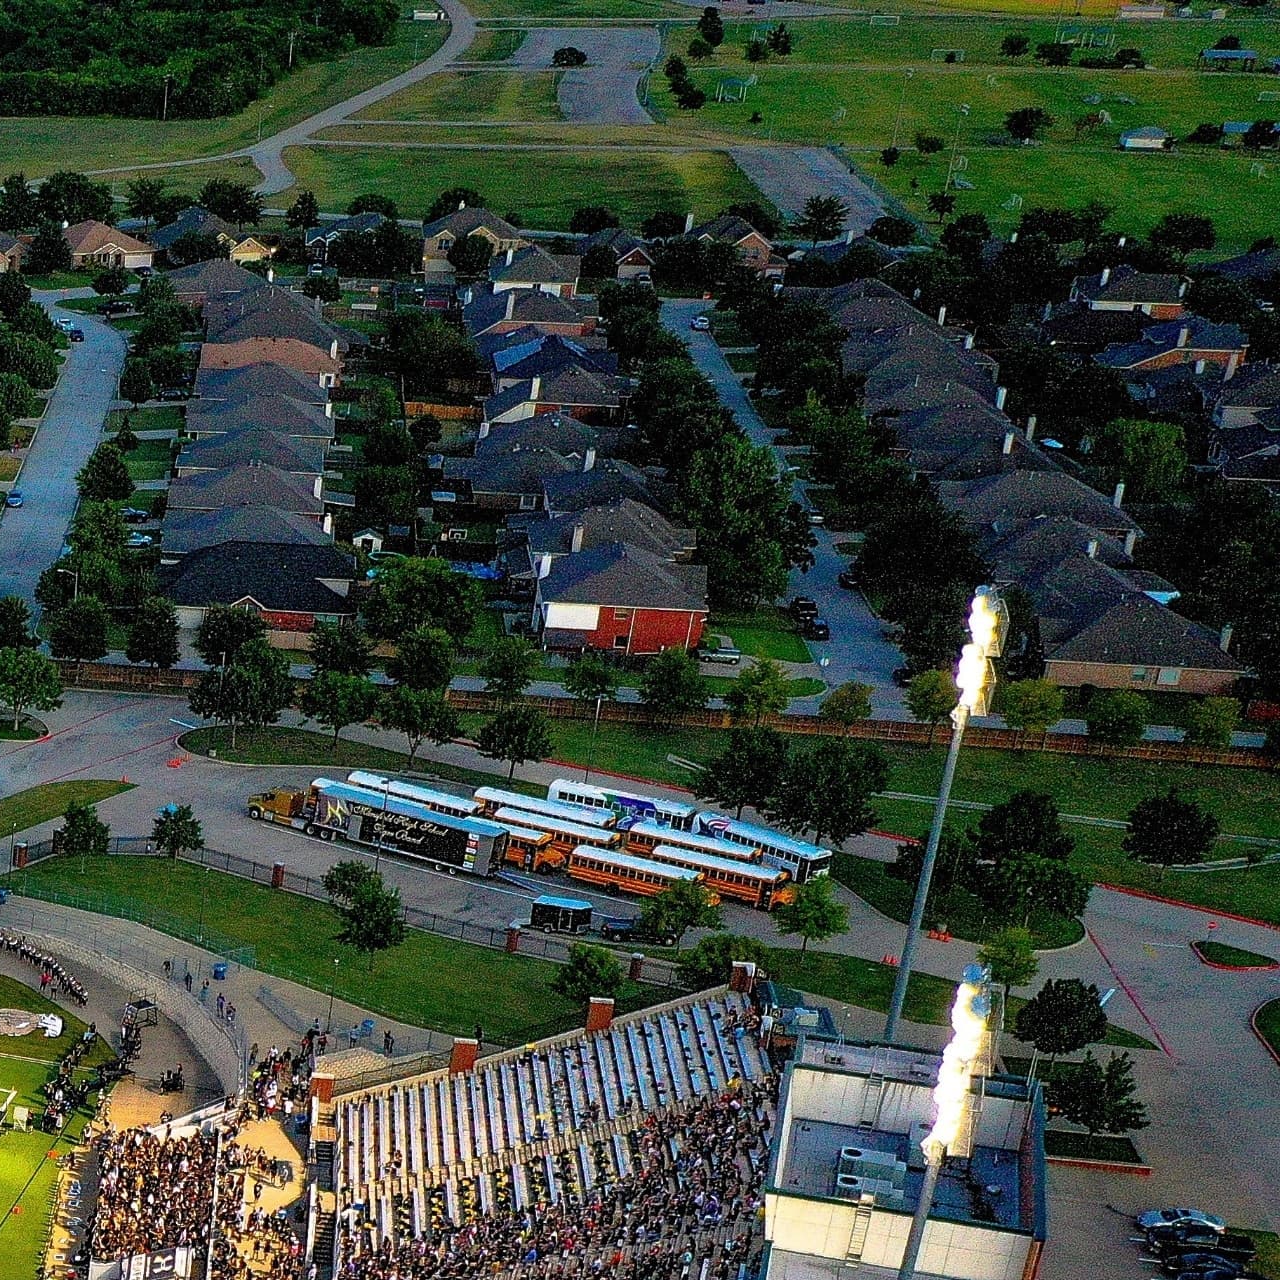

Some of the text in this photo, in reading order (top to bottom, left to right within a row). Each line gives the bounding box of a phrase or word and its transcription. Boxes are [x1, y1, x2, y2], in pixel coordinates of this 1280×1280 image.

[393, 815, 419, 832] High
[420, 822, 449, 837] School
[395, 829, 426, 845] Band
